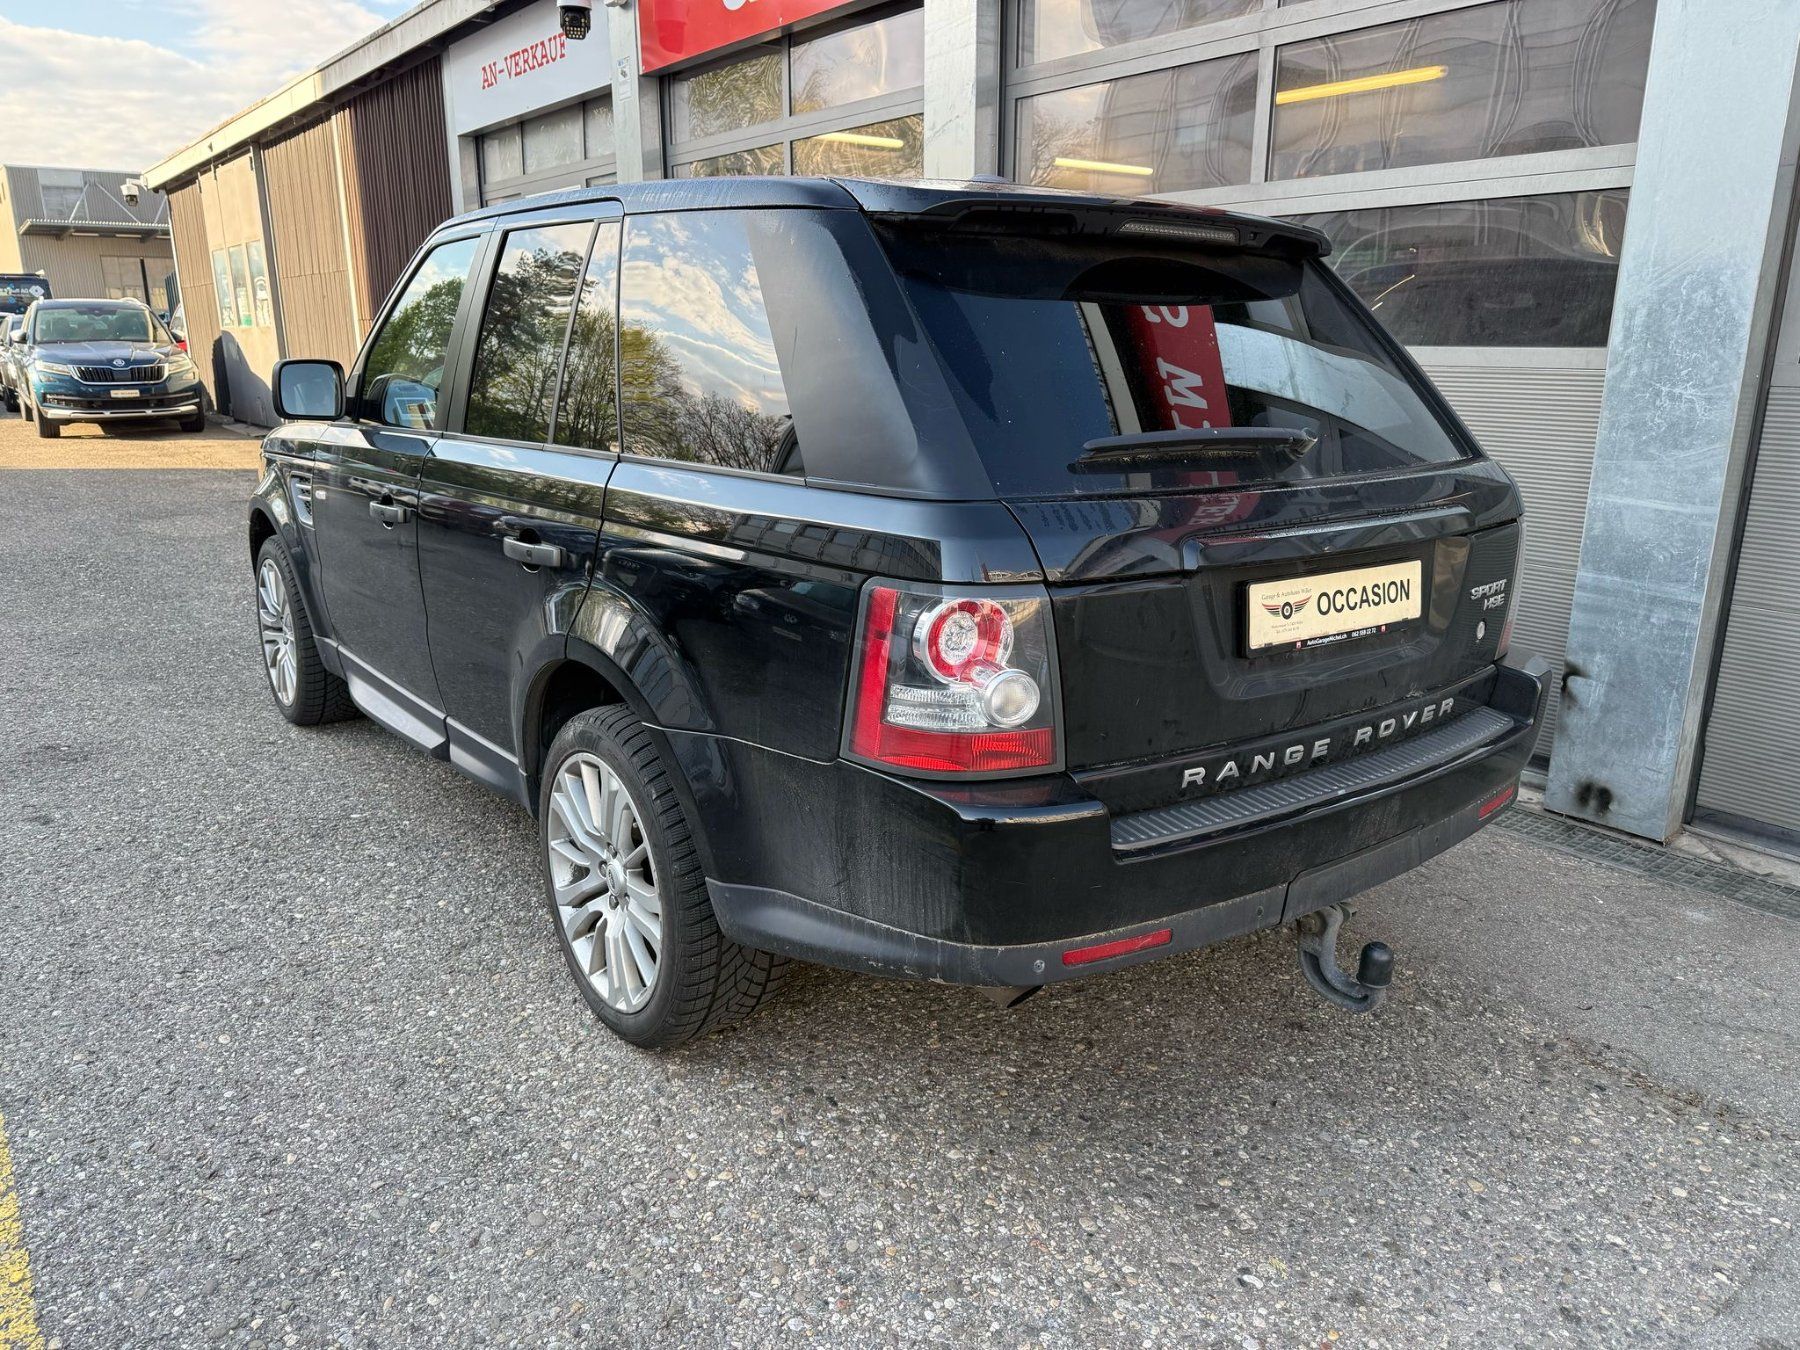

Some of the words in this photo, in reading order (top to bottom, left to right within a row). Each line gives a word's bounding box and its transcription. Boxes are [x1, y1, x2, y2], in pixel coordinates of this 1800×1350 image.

[481, 31, 567, 90] AN-VERKAUF
[1317, 578, 1410, 616] OCCASION
[1470, 578, 1507, 600] SPORT
[1483, 593, 1505, 611] HSE
[1181, 738, 1332, 788] RANGE
[1353, 697, 1455, 747] ROVER
